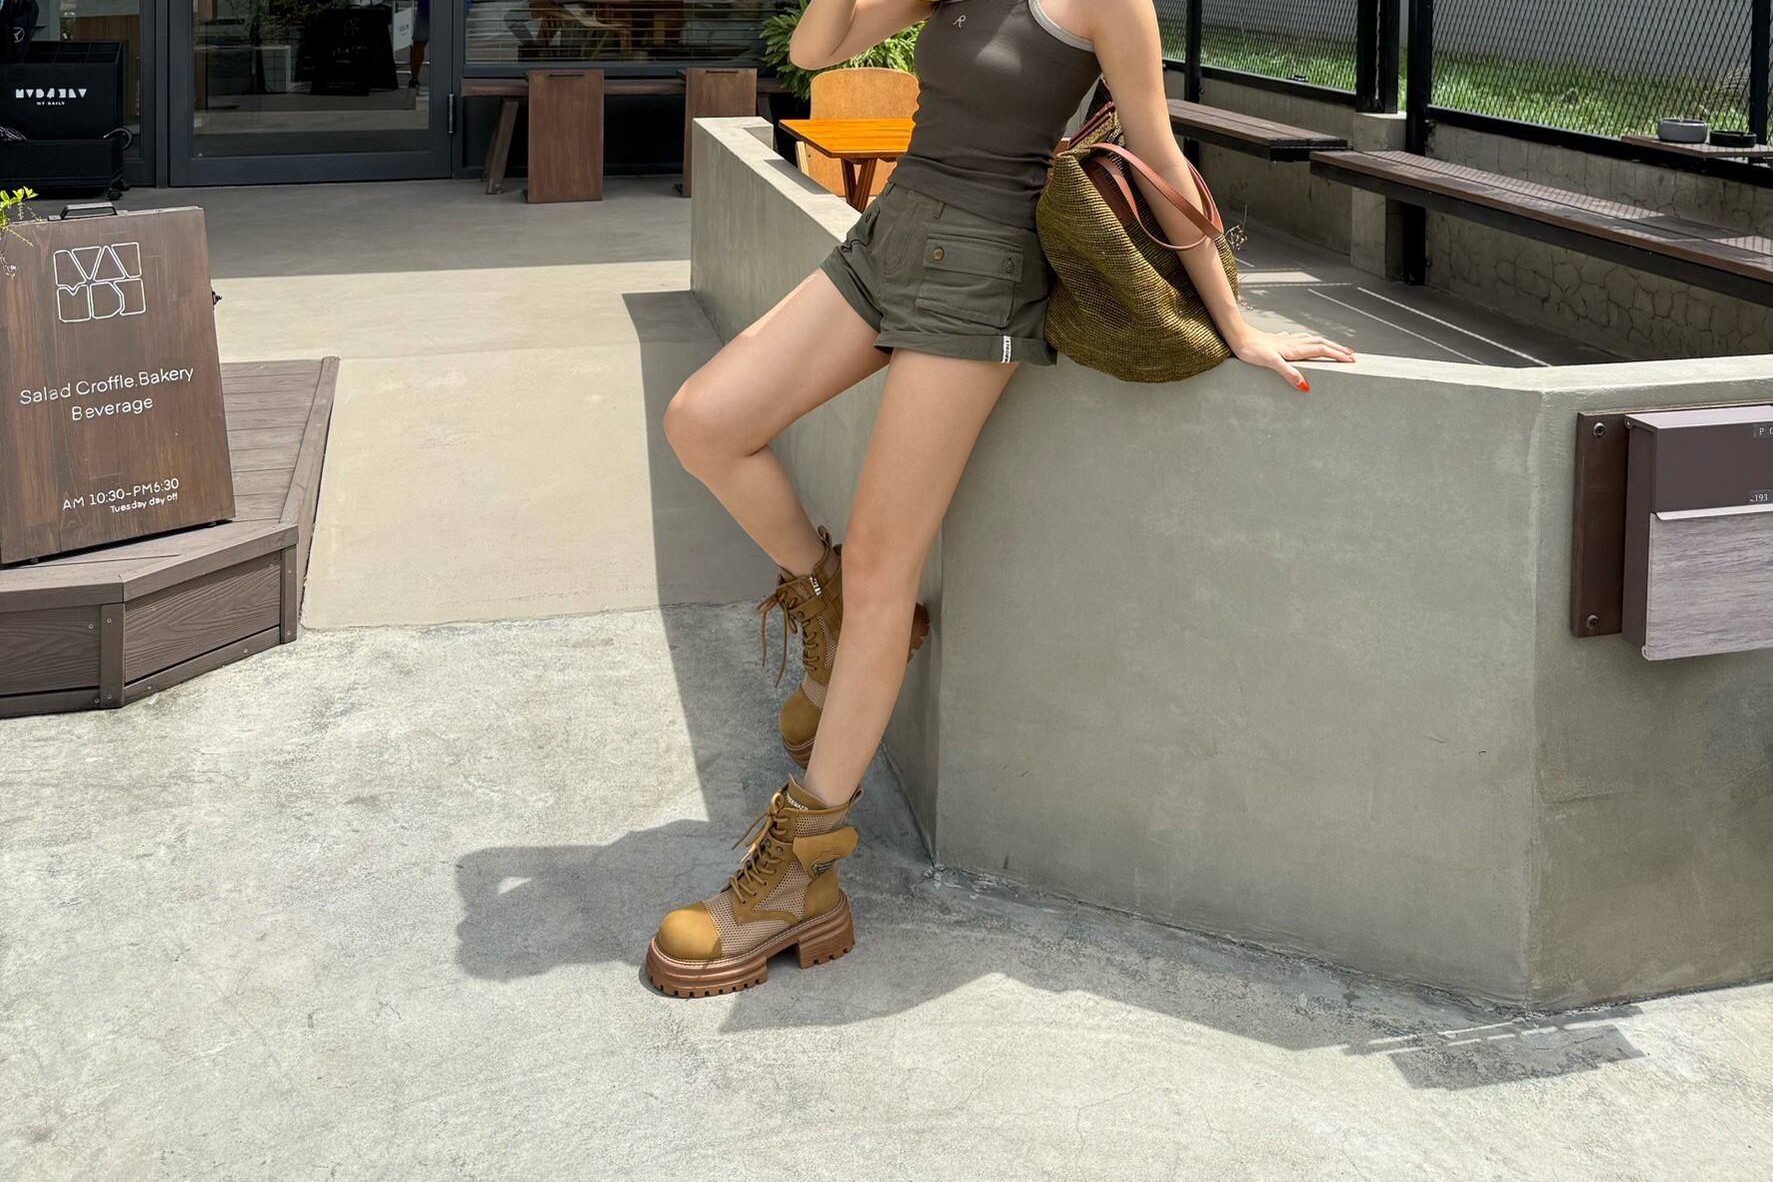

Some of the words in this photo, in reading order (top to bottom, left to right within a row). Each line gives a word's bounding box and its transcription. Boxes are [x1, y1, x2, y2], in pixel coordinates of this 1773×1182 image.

[20, 382, 72, 405] Salad
[71, 397, 154, 421] Beverage
[63, 496, 85, 510] AM
[110, 501, 147, 513] Tuesday
[149, 496, 165, 506] day
[166, 492, 178, 501] off
